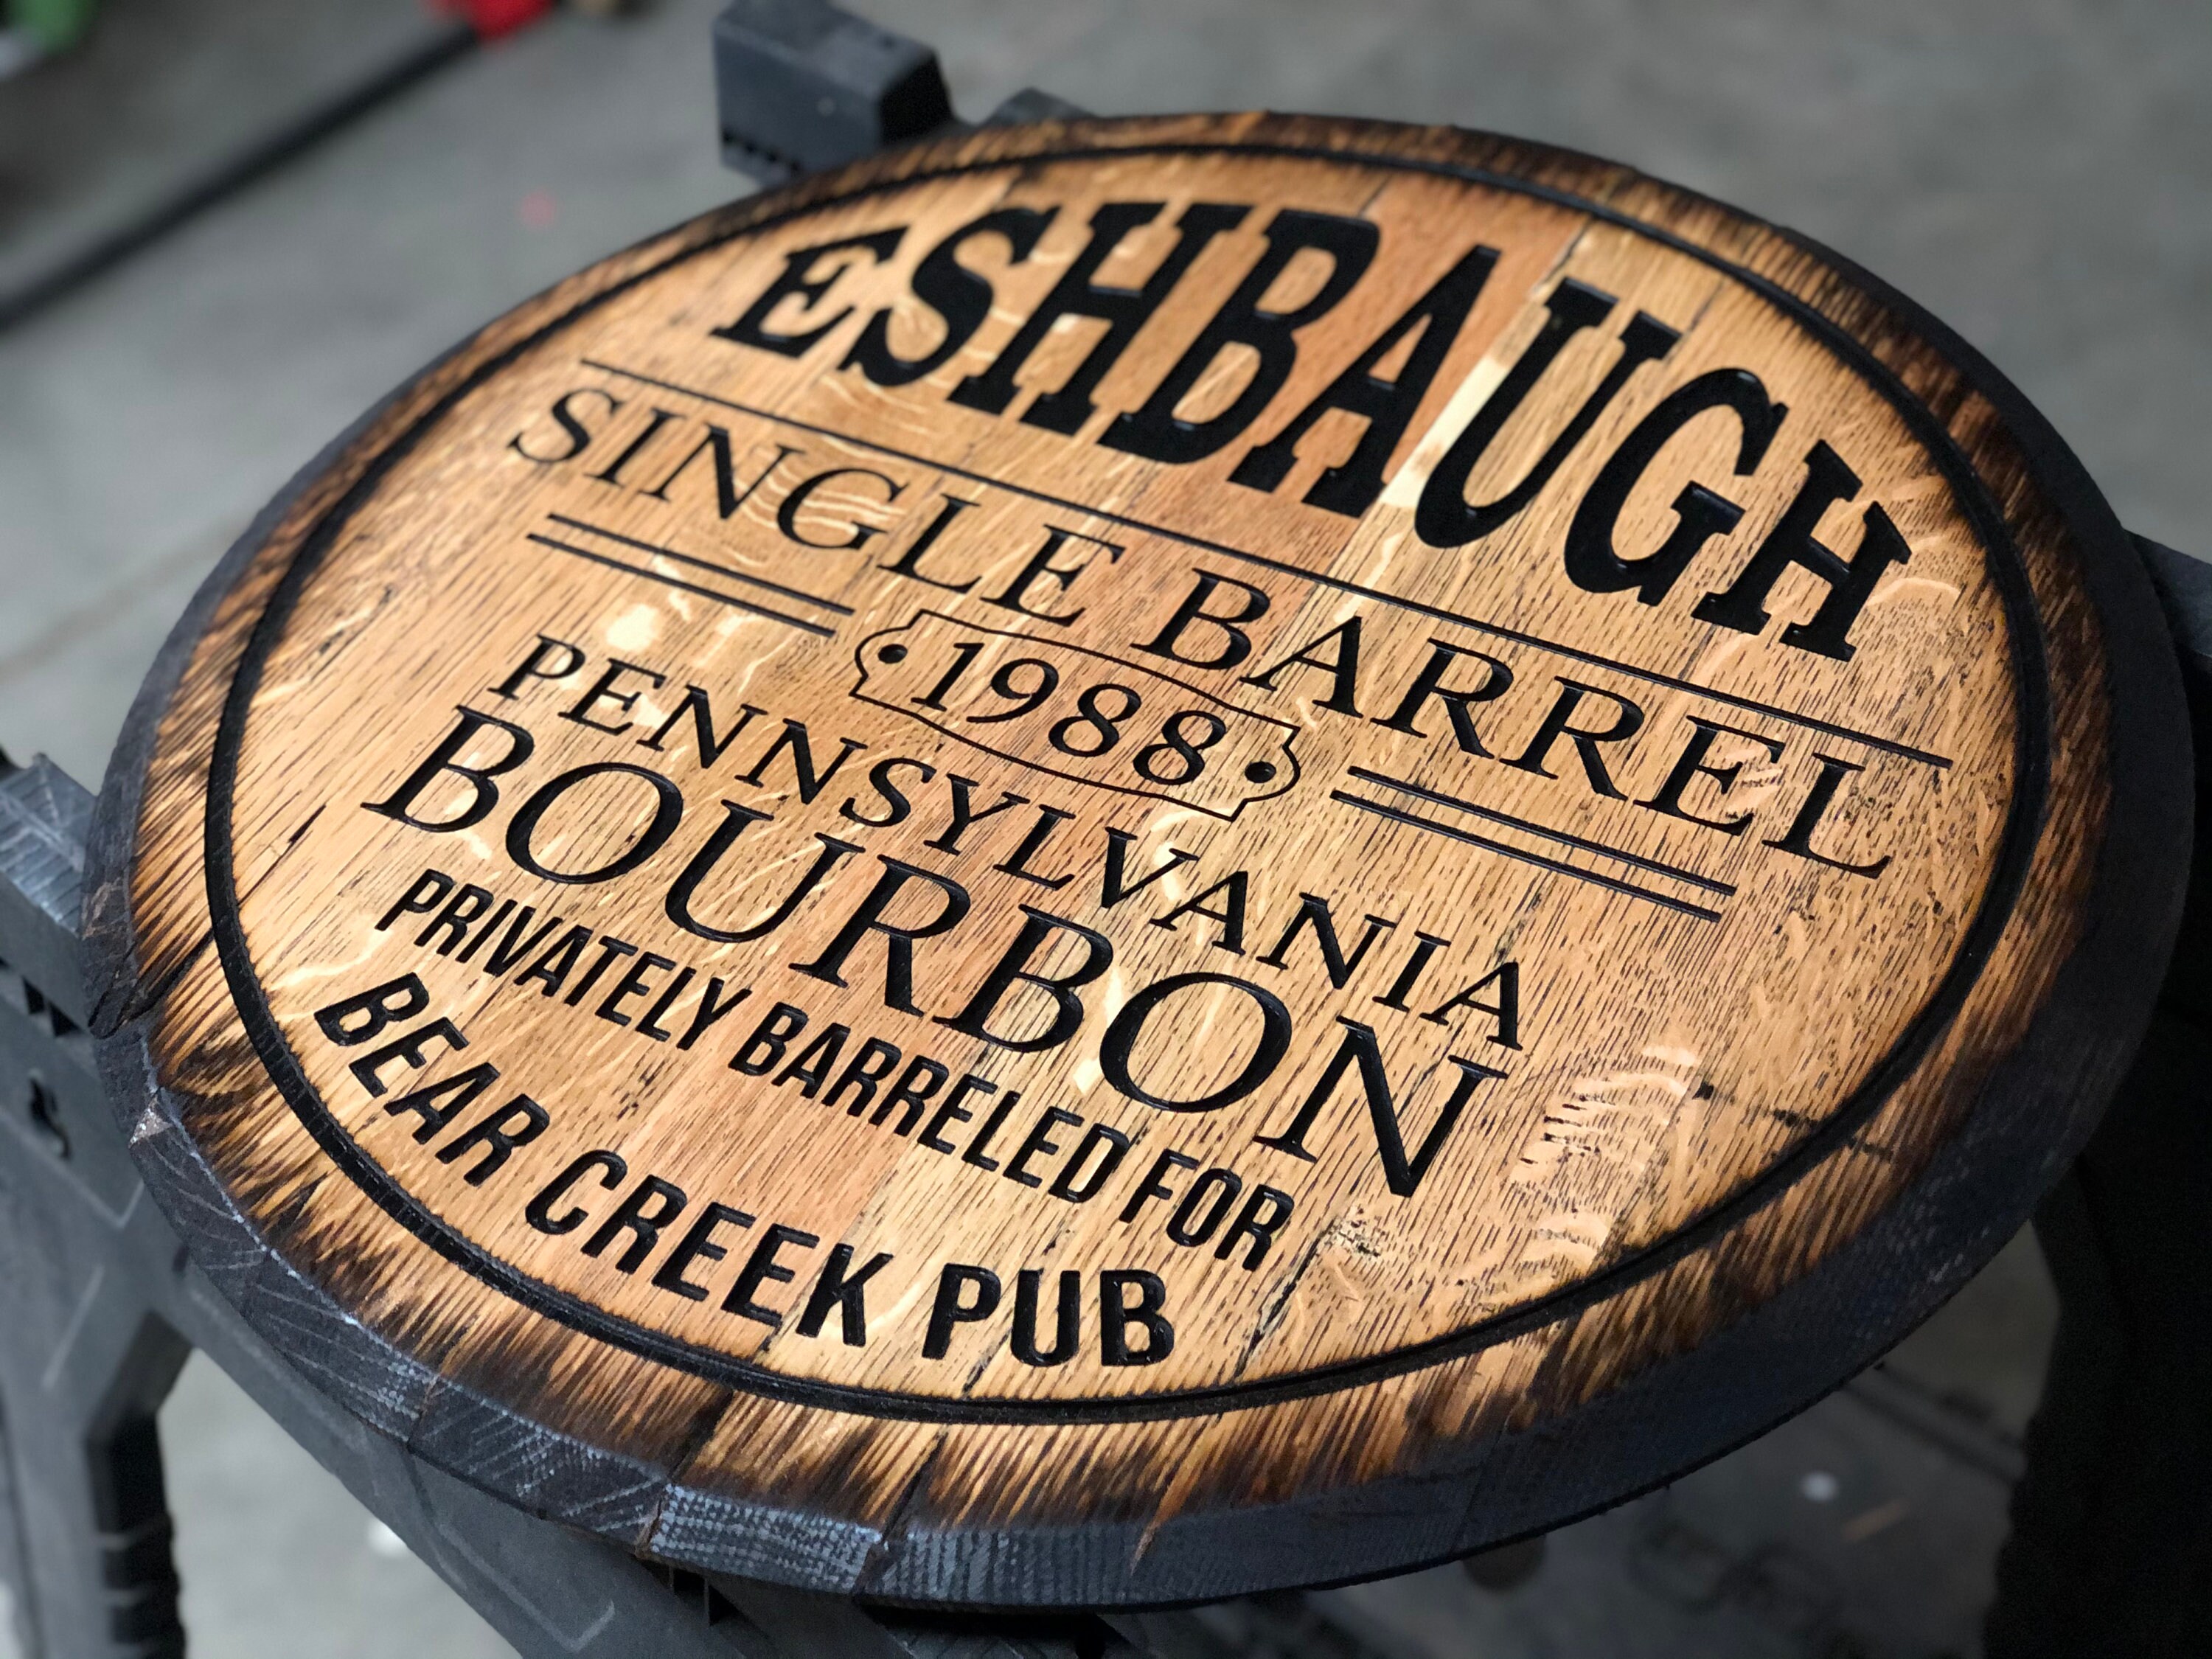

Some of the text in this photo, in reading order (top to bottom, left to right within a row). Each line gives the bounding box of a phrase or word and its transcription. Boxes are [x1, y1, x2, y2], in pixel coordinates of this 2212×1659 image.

[508, 389, 1893, 880] SINGLE BARREL
[709, 201, 1910, 662] ESHBAUGH
[488, 635, 1524, 1051] PENNSYLVANIA
[911, 641, 1227, 787] 1988
[361, 704, 1509, 1199] BOURBON
[375, 868, 1294, 1273] PRIVATELY BARRELED FOR
[313, 972, 1175, 1368] BEAR CREEK PUB
